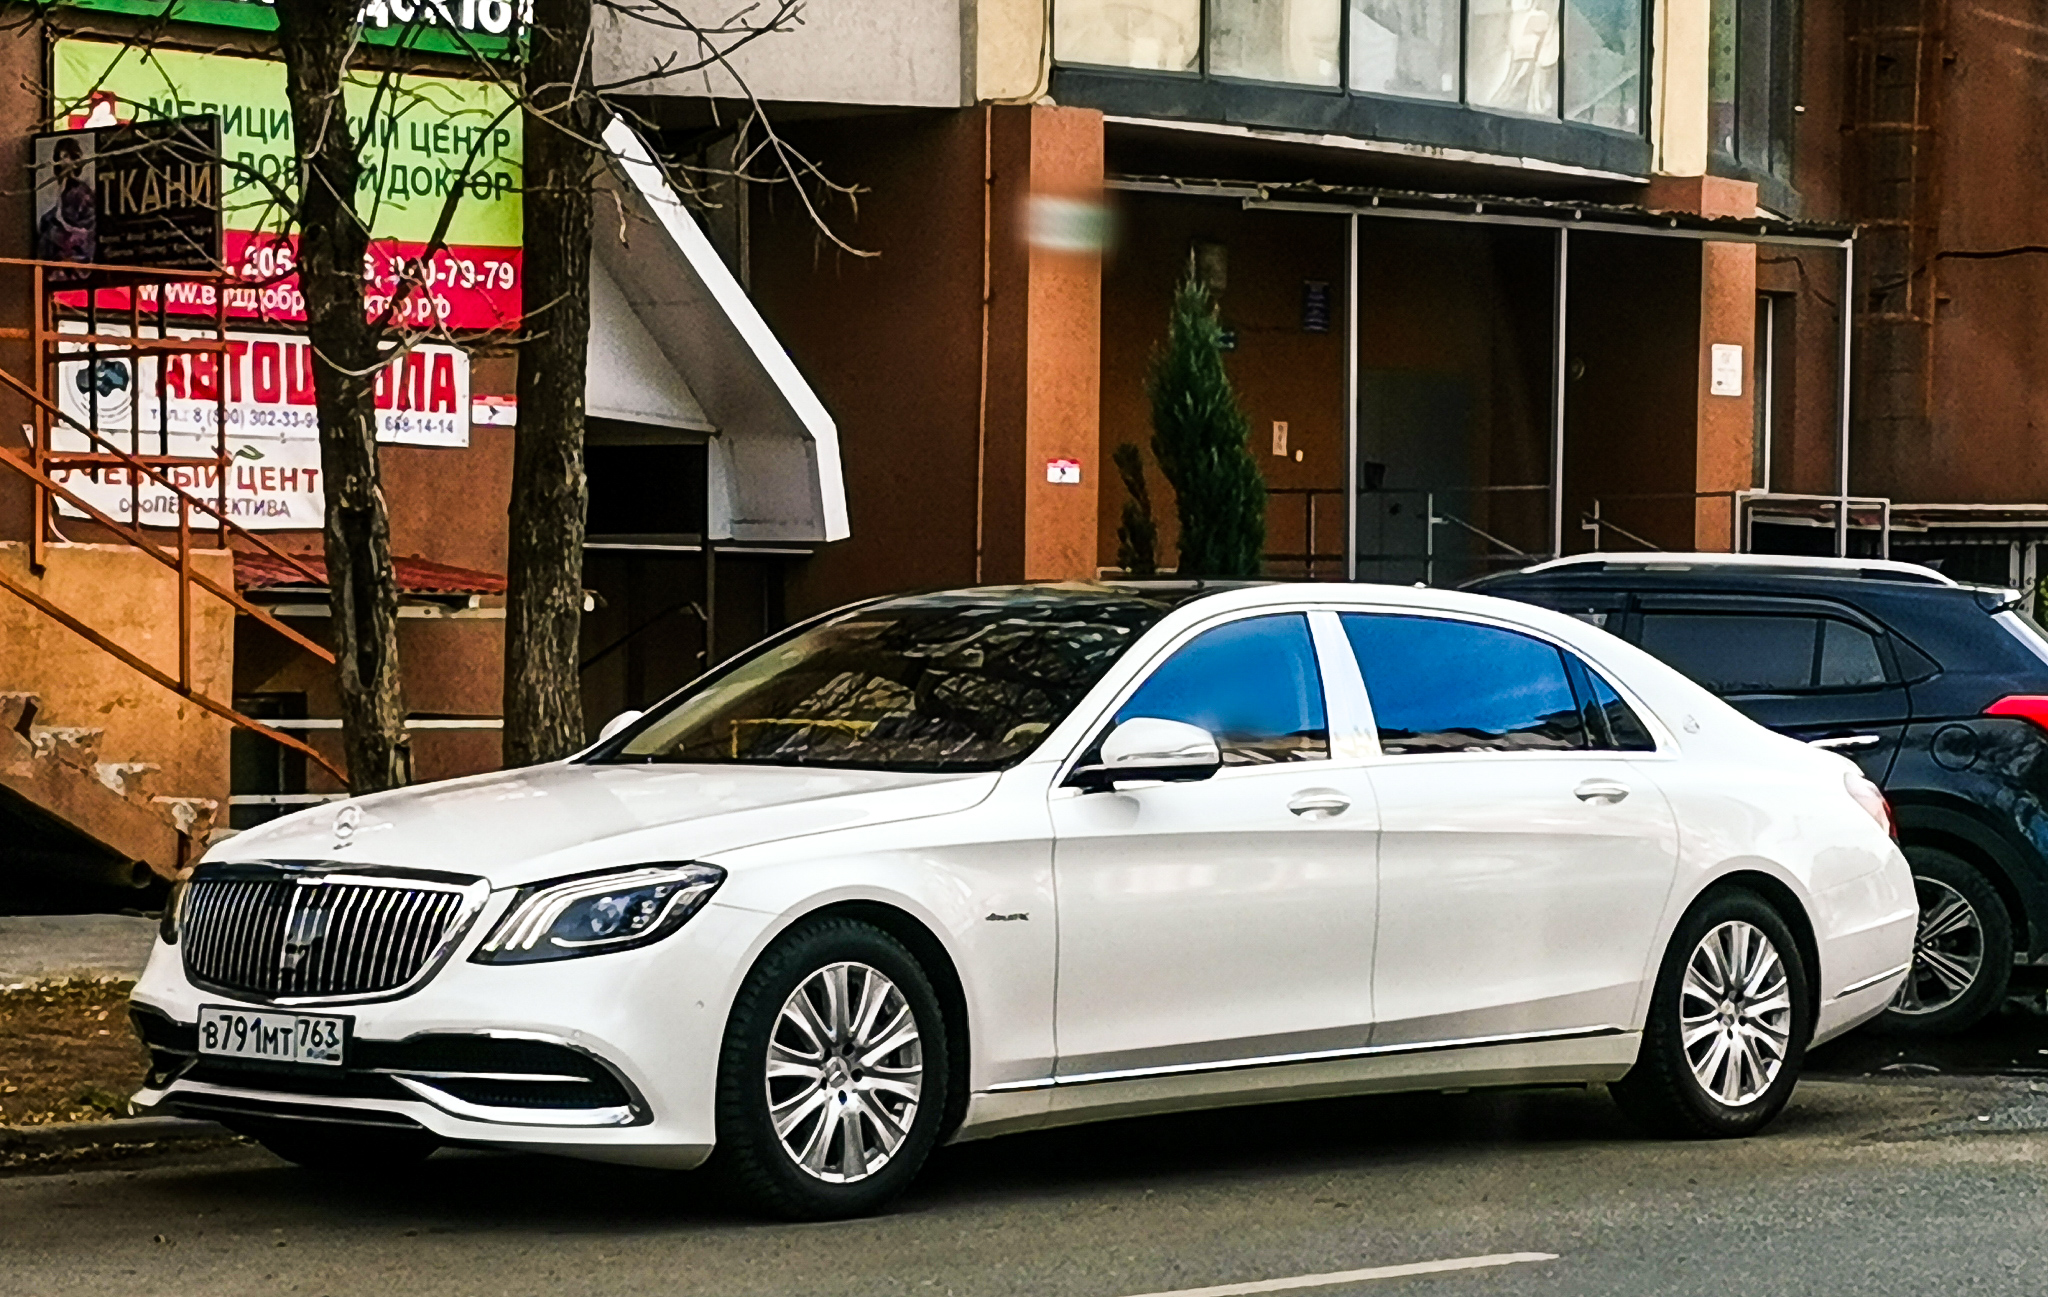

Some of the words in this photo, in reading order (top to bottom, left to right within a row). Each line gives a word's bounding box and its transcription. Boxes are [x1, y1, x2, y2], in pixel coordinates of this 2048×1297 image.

[410, 121, 511, 159] ЦЕНТР
[98, 162, 211, 216] ТКАНИ
[156, 337, 457, 414] АВТОШОЛА
[192, 407, 203, 423] 8
[236, 465, 319, 495] ЦЕНТ
[202, 1014, 294, 1056] В791МТ
[298, 1018, 341, 1049] 763
